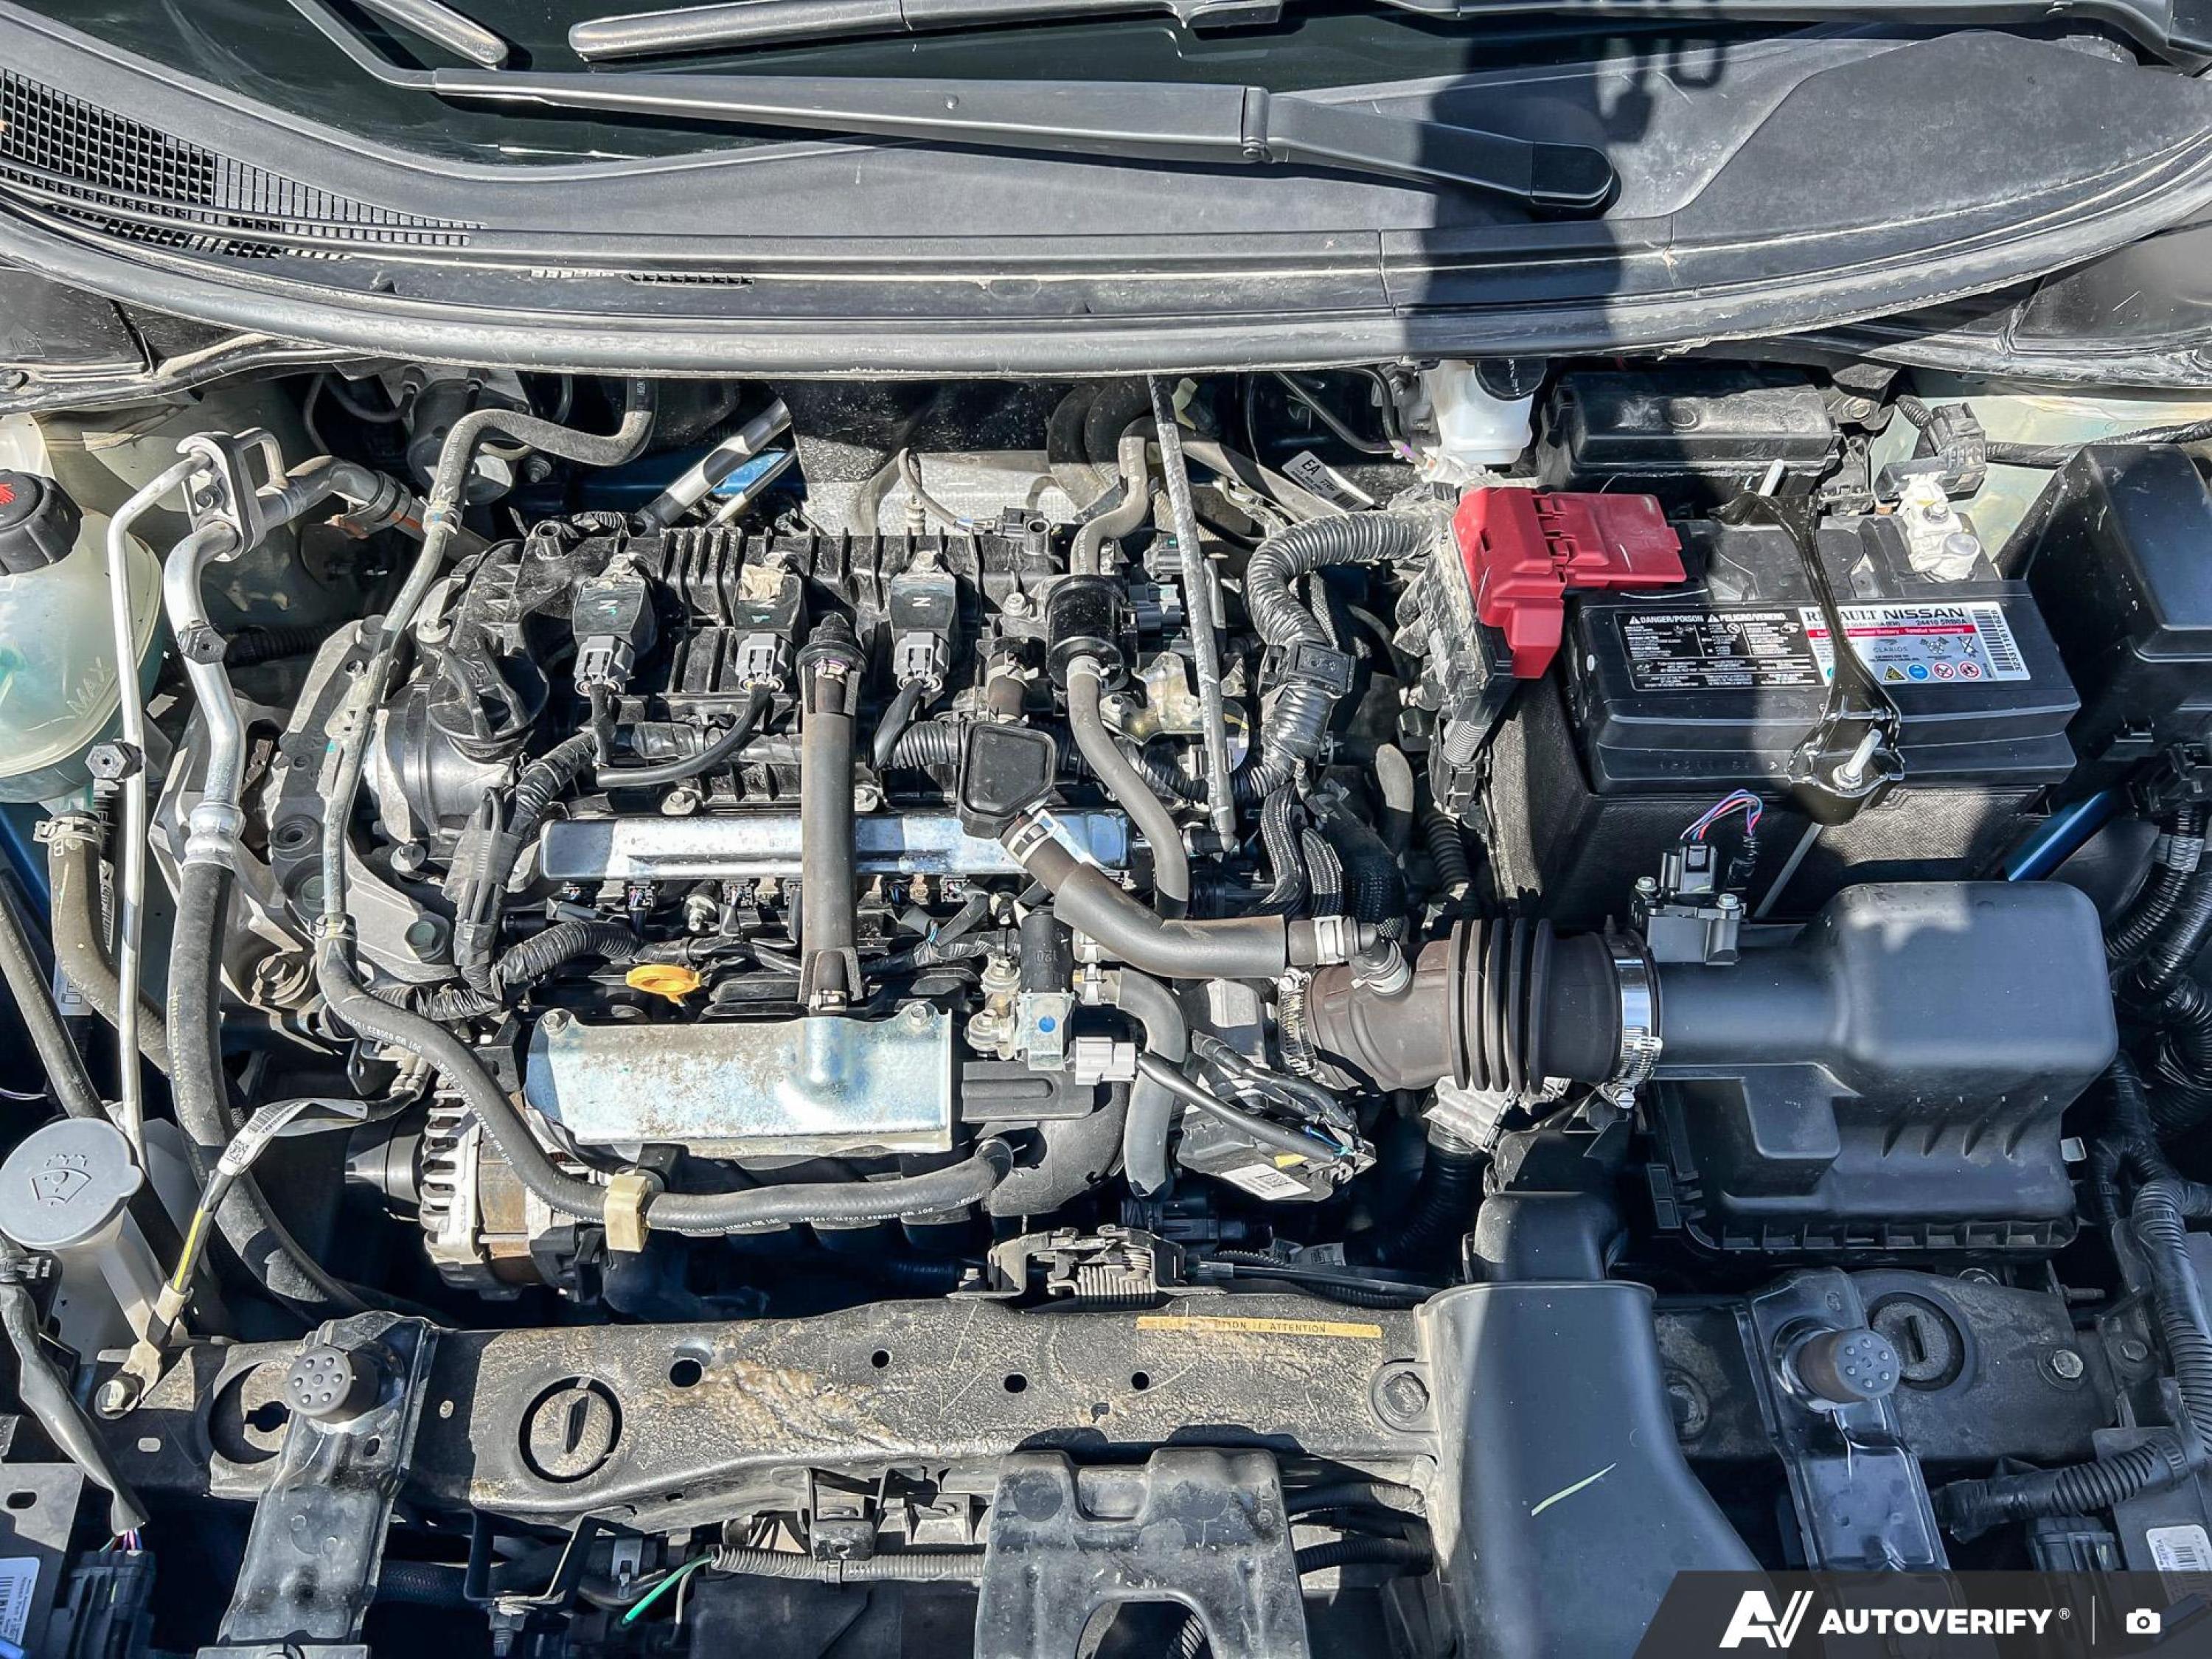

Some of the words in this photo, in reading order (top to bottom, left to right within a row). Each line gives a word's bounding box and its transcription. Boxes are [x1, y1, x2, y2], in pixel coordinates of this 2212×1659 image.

[1301, 459, 1321, 476] EA
[1640, 615, 1705, 623] DANGER/POISON
[1806, 611, 1877, 621] RAULT
[1883, 608, 1964, 619] NISSAN
[1270, 1323, 1326, 1332] ATTENTION
